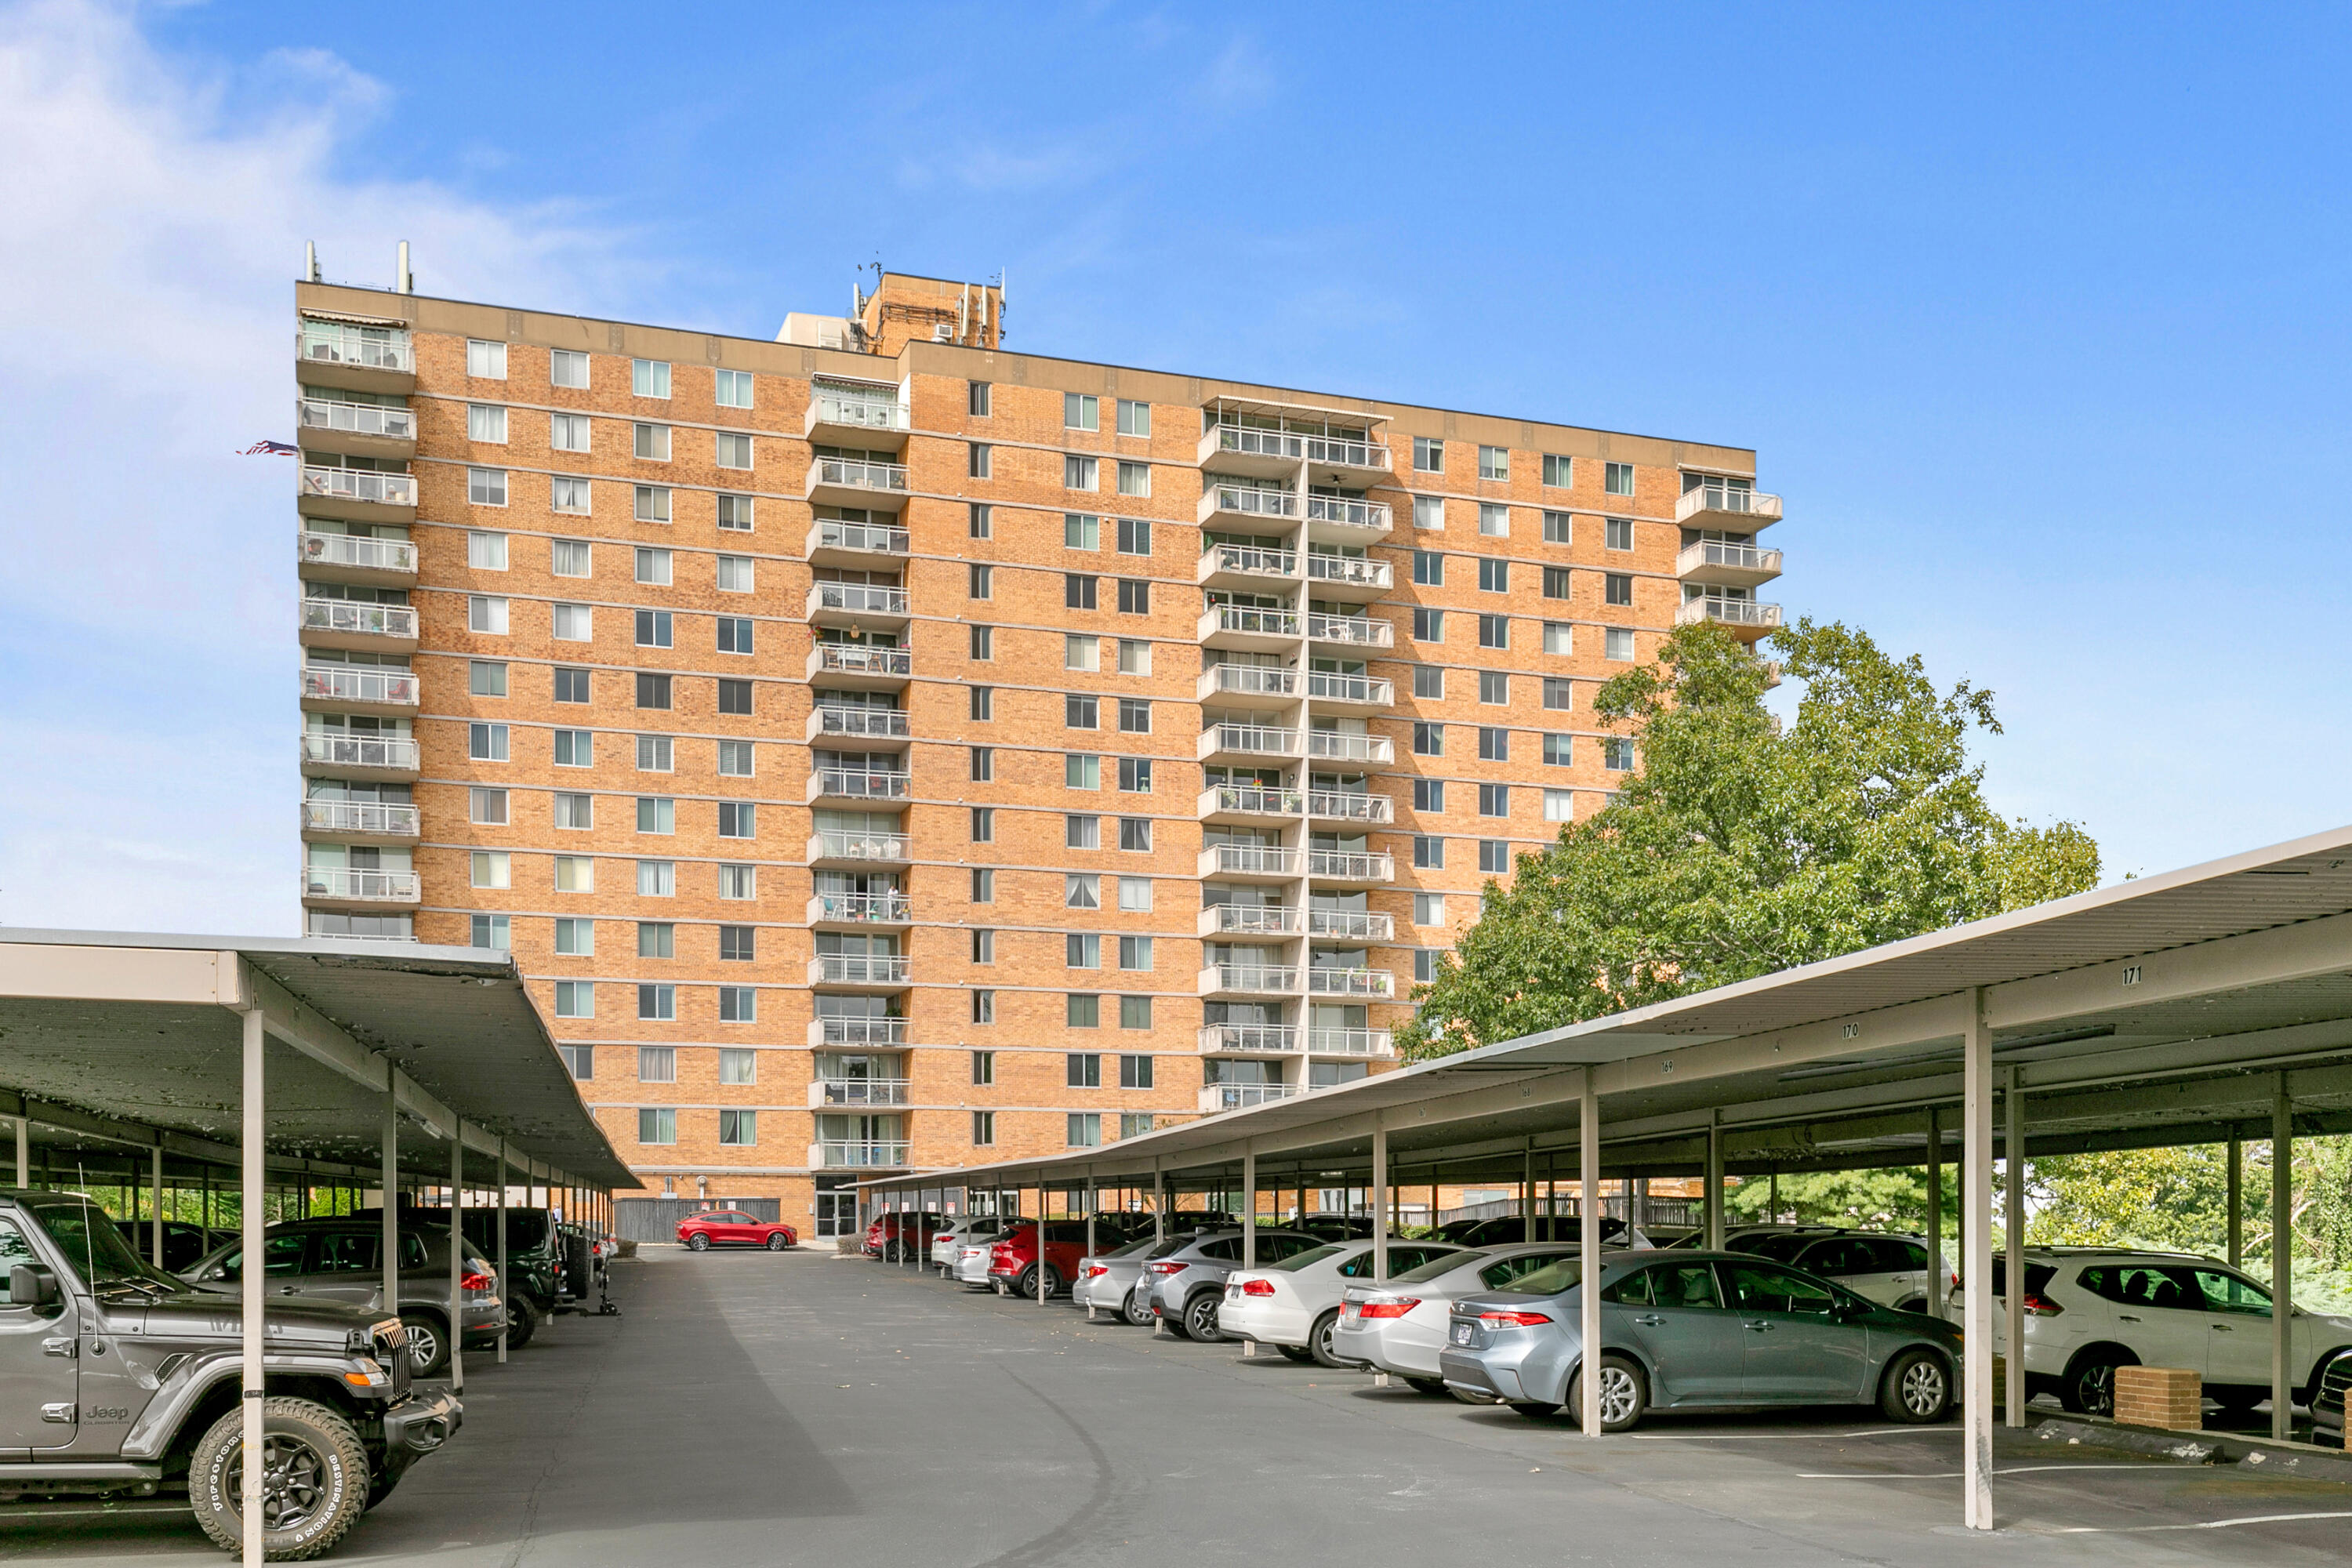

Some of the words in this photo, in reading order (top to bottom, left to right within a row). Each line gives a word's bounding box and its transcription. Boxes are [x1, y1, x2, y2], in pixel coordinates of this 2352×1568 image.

[2123, 965, 2142, 985] 171
[1843, 1023, 1858, 1038] 170
[1662, 1060, 1673, 1073] 169
[85, 1404, 129, 1420] Jeep
[304, 1454, 343, 1537] DESTINATION
